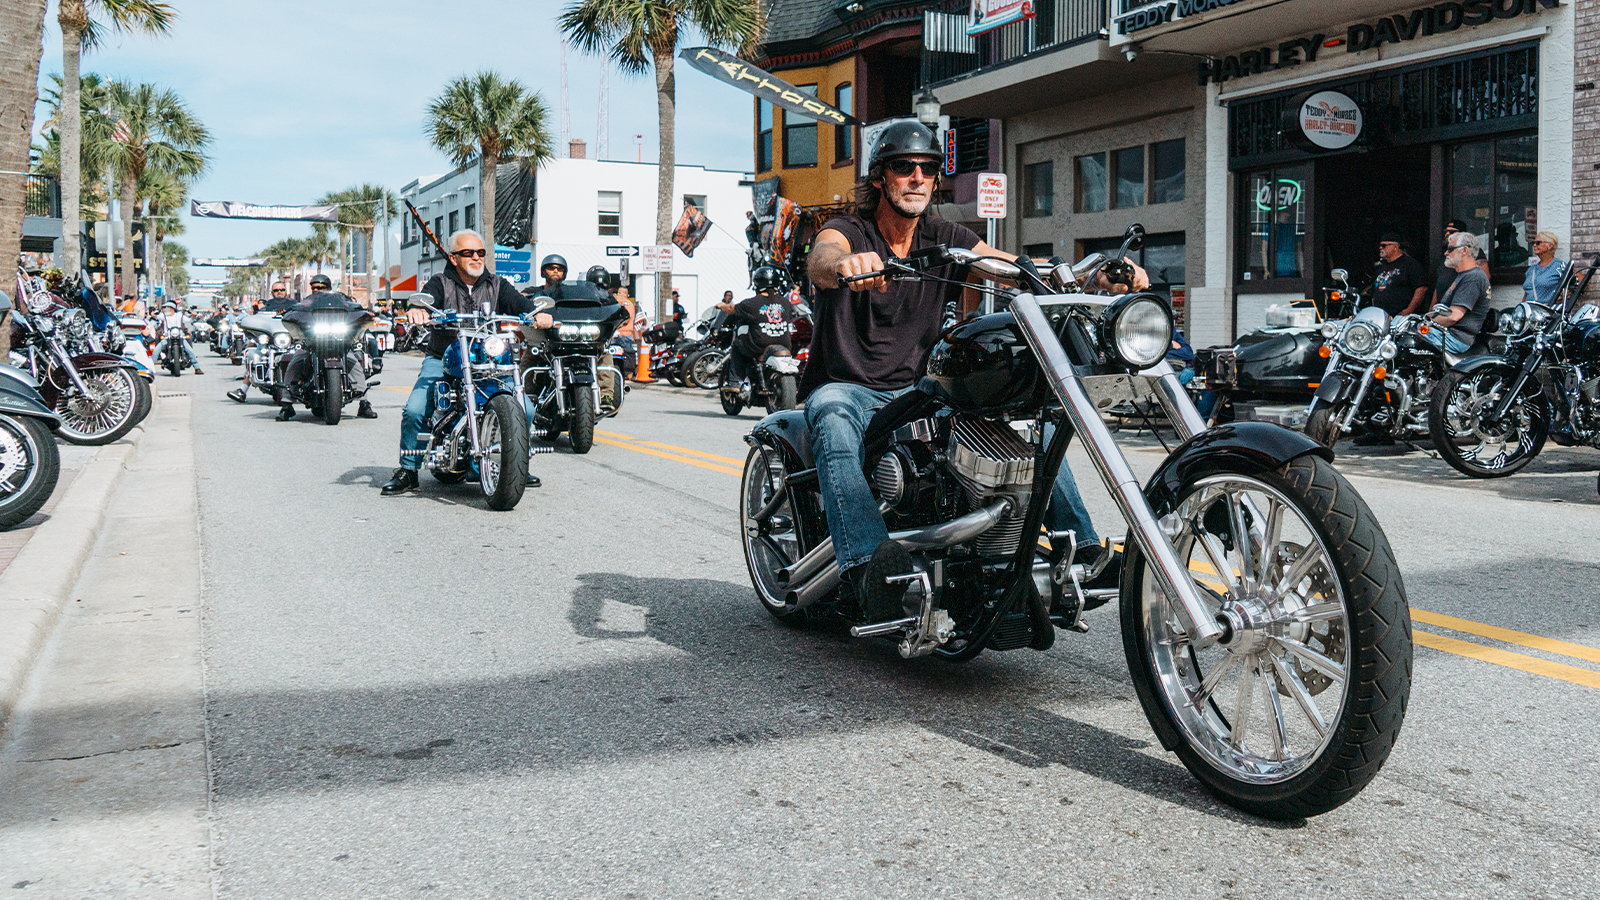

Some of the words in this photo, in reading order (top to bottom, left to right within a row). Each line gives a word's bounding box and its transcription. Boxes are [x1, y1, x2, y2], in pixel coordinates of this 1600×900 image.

[1114, 4, 1175, 35] TEDDY
[1177, 0, 1244, 17] MOR
[1306, 104, 1326, 117] TEDDY
[1305, 119, 1356, 134] HARLEY-DAVIDSON
[947, 130, 955, 172] TATTOO
[229, 204, 272, 217] WELCOME
[273, 207, 302, 218] RIDERS
[89, 257, 142, 268] STET
